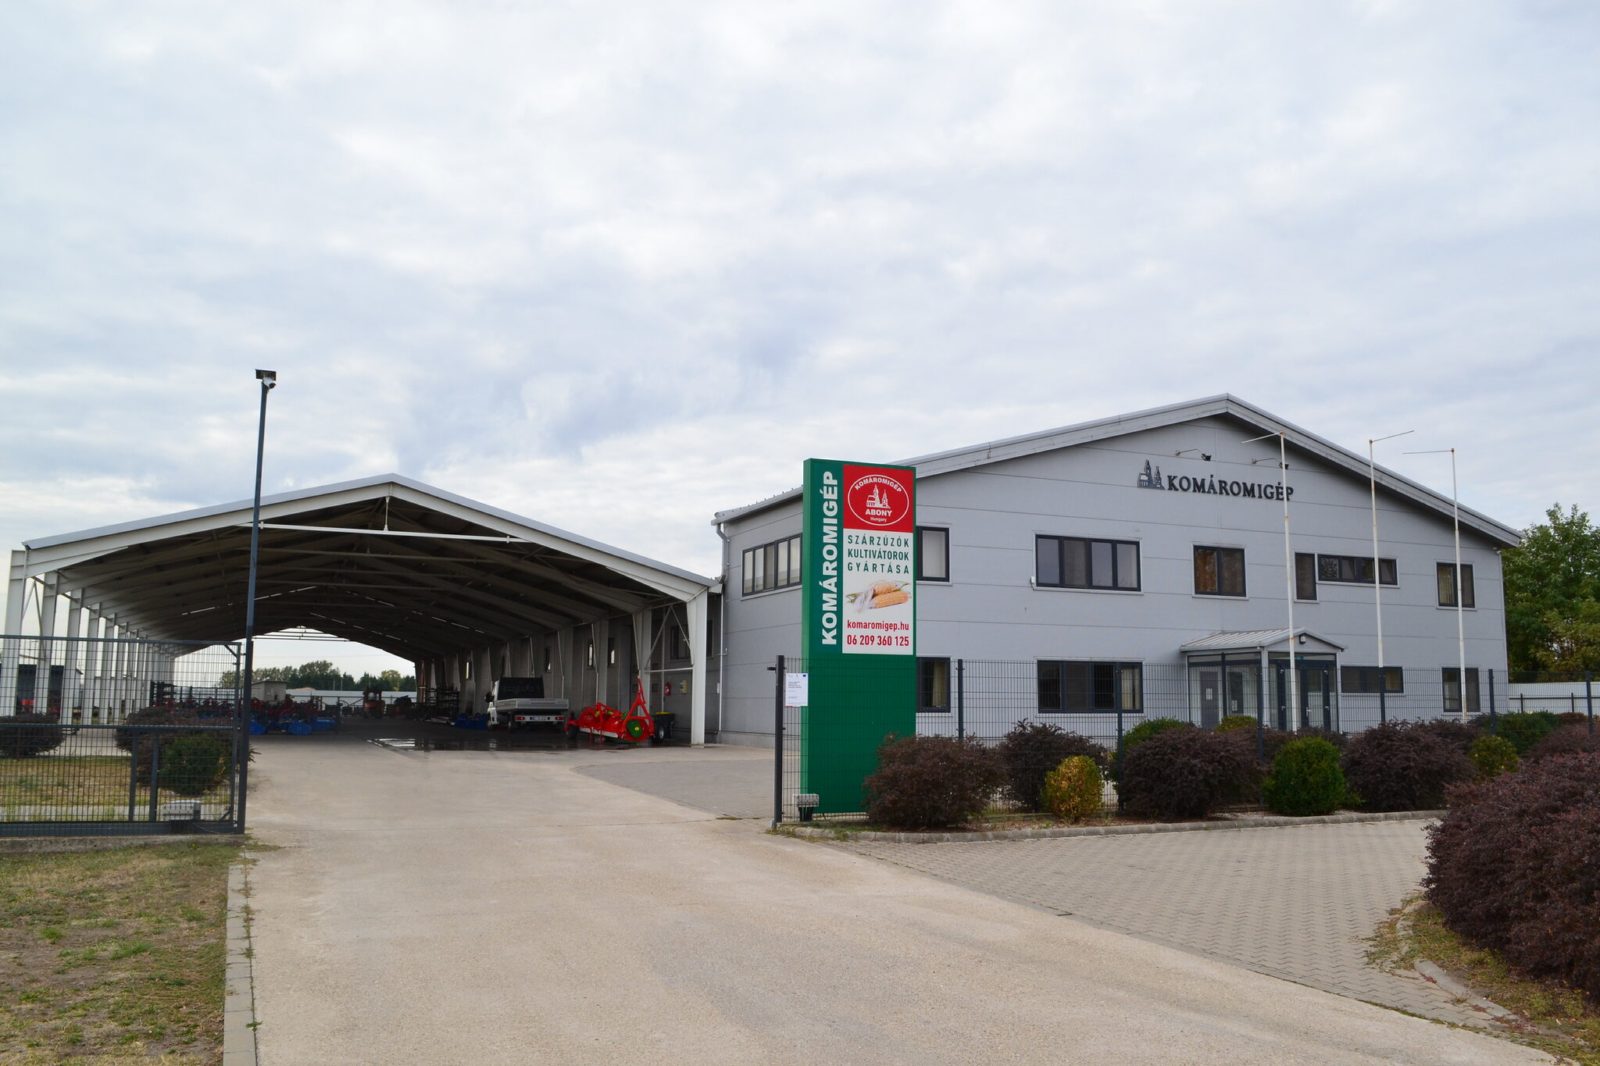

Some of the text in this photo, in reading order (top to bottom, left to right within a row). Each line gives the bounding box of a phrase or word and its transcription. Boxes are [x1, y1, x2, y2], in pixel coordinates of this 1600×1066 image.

[854, 476, 902, 493] KOMÁROMIGÉP
[1167, 474, 1294, 501] KOMÁROMIGÉP
[865, 509, 892, 517] ABONY
[847, 534, 909, 547] SZÁRZÚZÓK
[819, 471, 838, 645] KOMÁROMIGÉP
[847, 548, 909, 560] KULTIVÁTOROK
[847, 561, 909, 574] GYÁRTÁSA
[847, 620, 909, 631] komaromigep.hu
[847, 635, 909, 646] 06 209 360 125
